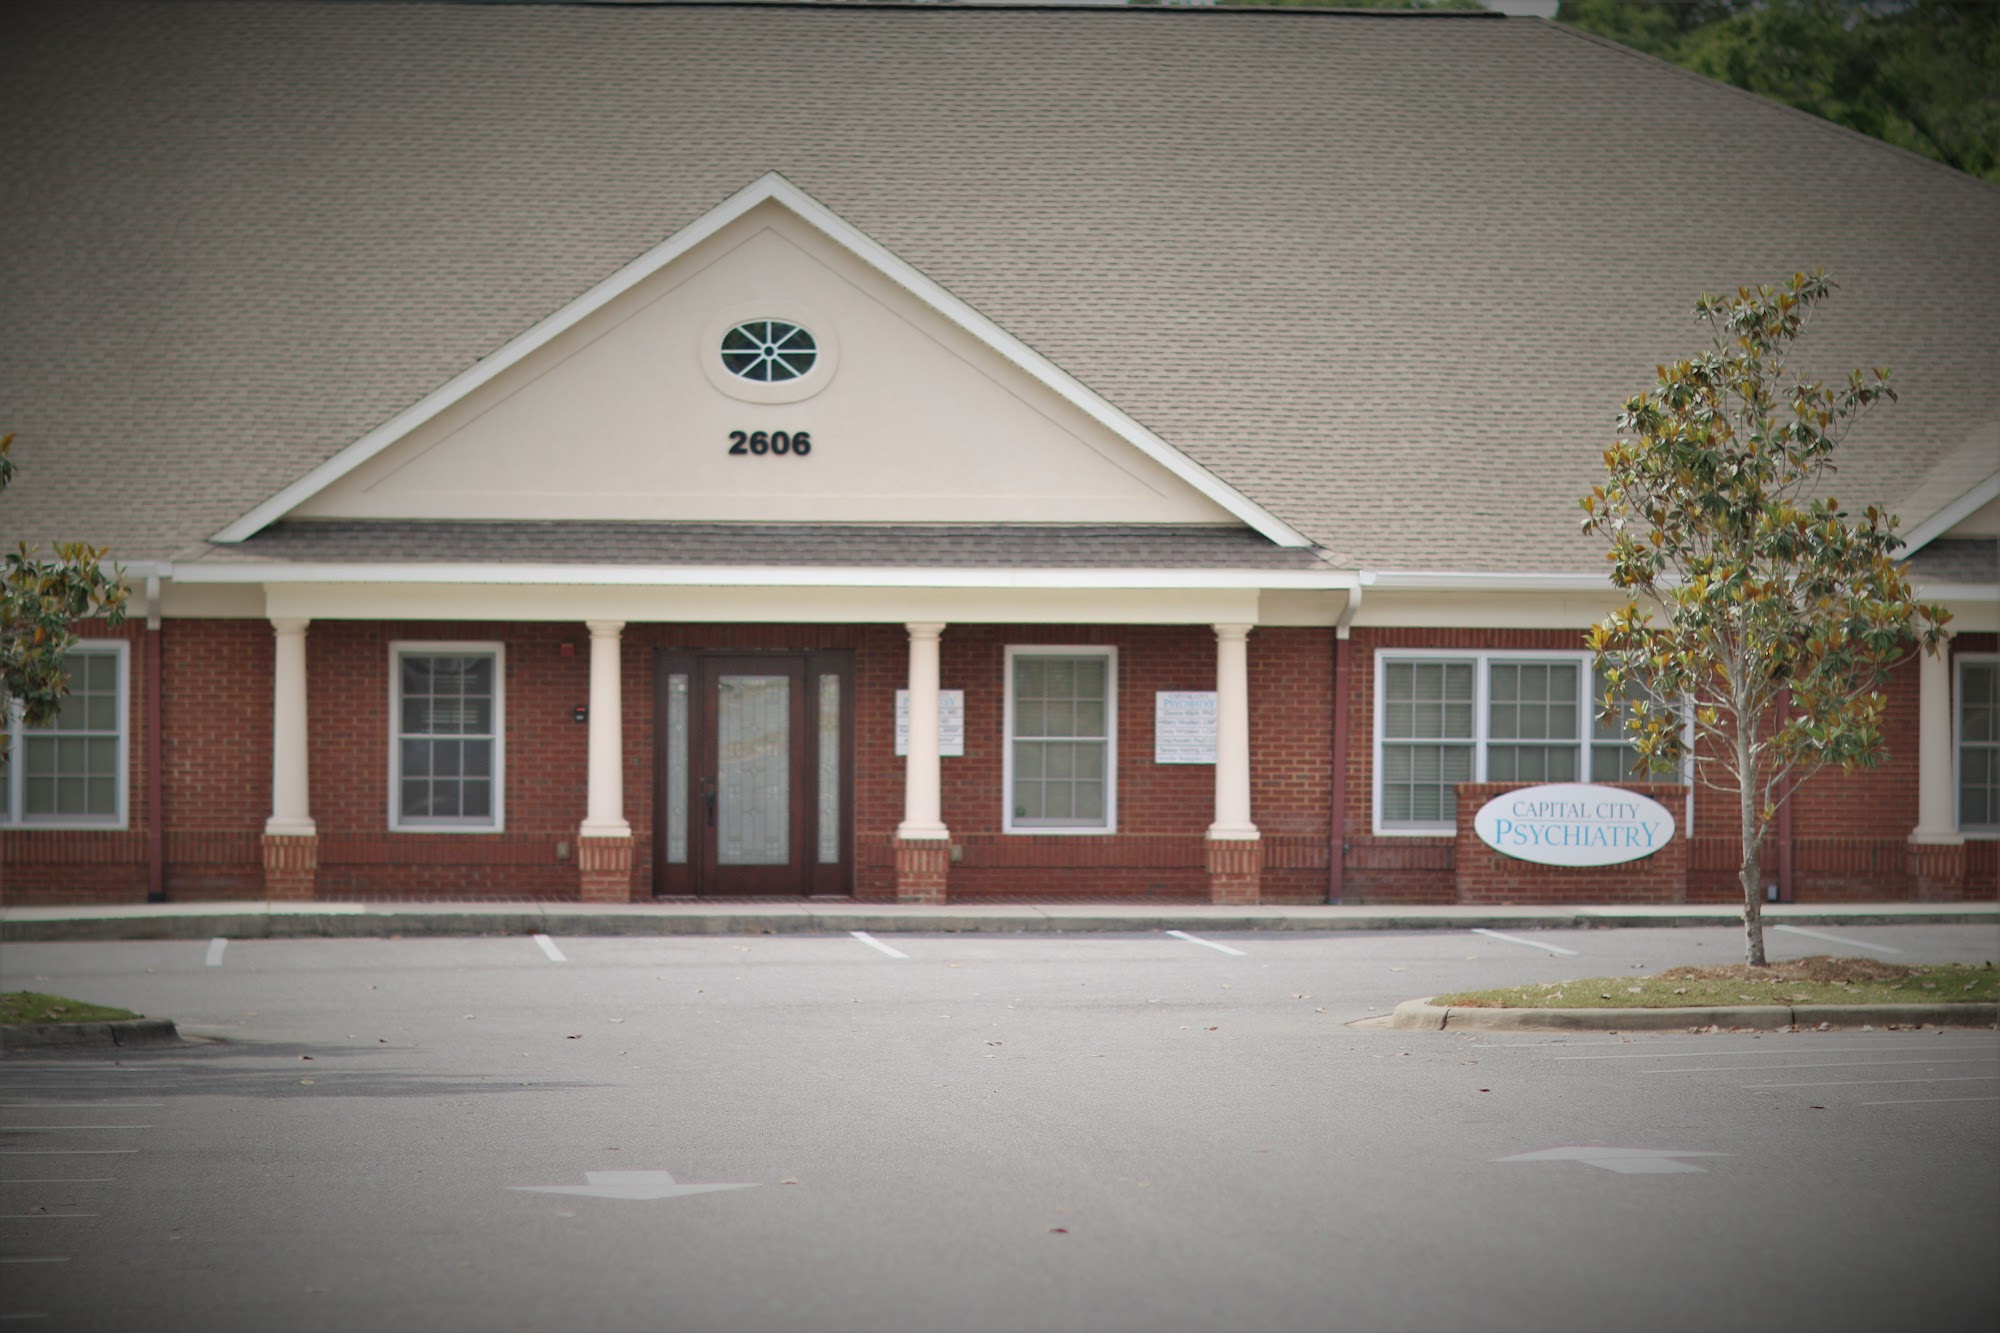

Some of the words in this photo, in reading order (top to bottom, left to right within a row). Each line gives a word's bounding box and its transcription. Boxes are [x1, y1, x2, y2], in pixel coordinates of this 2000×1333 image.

[728, 430, 811, 456] 2606
[1512, 801, 1592, 818] CAPITAL
[1596, 803, 1640, 819] CITY
[1494, 819, 1660, 847] PSYCHIATRY
